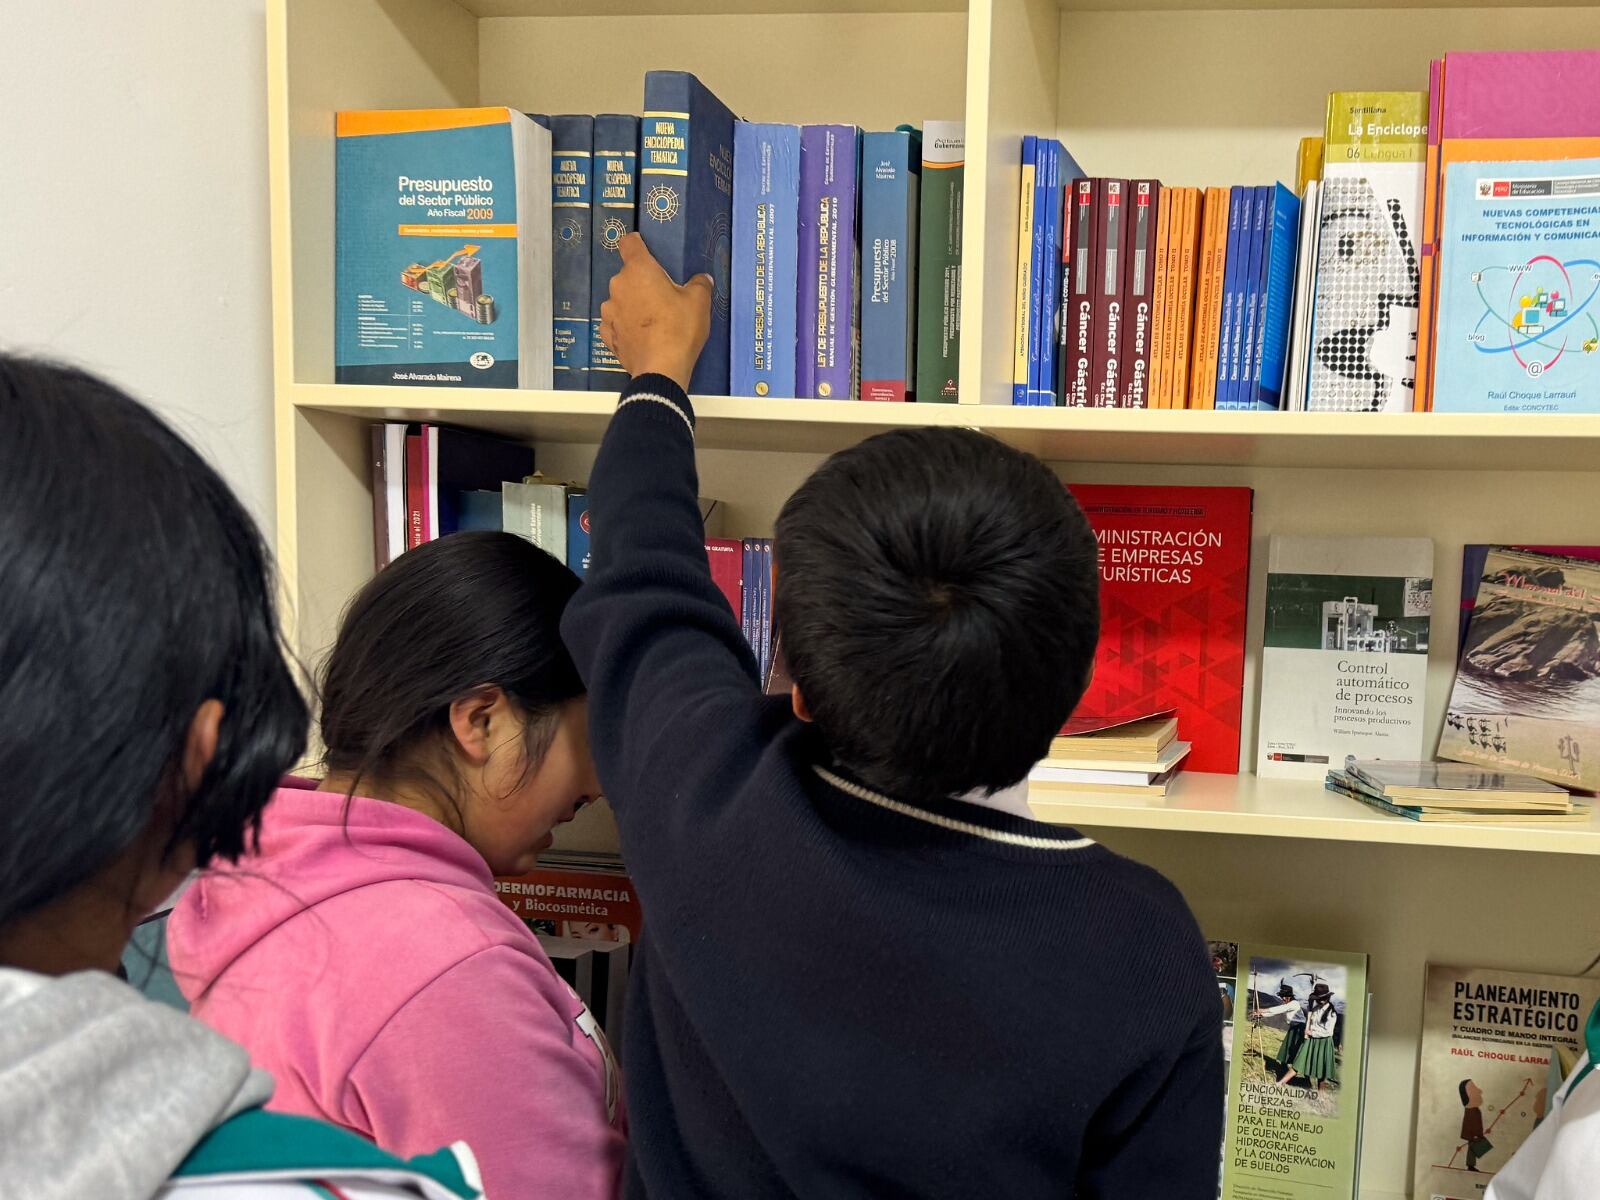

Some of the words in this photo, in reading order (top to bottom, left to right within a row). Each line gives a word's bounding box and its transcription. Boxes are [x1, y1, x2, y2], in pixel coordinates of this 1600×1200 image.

[1350, 107, 1387, 115] Santillana
[655, 122, 675, 135] NUEVA
[1348, 123, 1363, 137] La
[644, 136, 685, 150] ENCICLOPEDIA
[650, 151, 678, 165] TEMATICA
[1346, 147, 1360, 159] 06
[560, 160, 577, 172] NUEVA
[606, 160, 624, 172] NUEVA
[398, 175, 493, 195] Presupuesto
[398, 194, 416, 206] del
[417, 194, 453, 206] Sector
[454, 193, 494, 206] Público
[427, 208, 443, 217] Año
[443, 208, 466, 217] Fiscal
[466, 208, 493, 220] 2009
[817, 197, 829, 245] REPÚBLICA
[1482, 209, 1522, 217] NUEVAS
[756, 203, 766, 251] REPUBLICA
[1495, 219, 1573, 230] TECNOLÓGICAS
[1576, 219, 1590, 227] EN
[1461, 232, 1531, 242] INFORMACIÓN
[1534, 233, 1541, 241] Y
[756, 252, 765, 264] LA
[819, 247, 828, 259] LA
[756, 265, 765, 277] DE
[819, 260, 828, 273] DE
[871, 238, 883, 303] Presupuesto
[755, 278, 765, 340] PRESUPUESTO
[818, 274, 828, 336] PRESUPUESTO
[767, 328, 773, 338] DE
[829, 325, 835, 335] DE
[1078, 301, 1090, 353] Cáncer
[1107, 302, 1119, 355] Cáncer
[1135, 302, 1148, 355] Cáncer
[755, 341, 764, 352] DE
[817, 338, 826, 350] DE
[755, 353, 763, 370] LEY
[817, 351, 826, 367] LEY
[392, 372, 408, 380] José
[408, 372, 437, 381] Alvarado
[437, 373, 462, 382] Mairena
[1527, 361, 1543, 377] @
[1076, 358, 1088, 408] Gástri
[1105, 358, 1117, 408] Gástri
[1133, 359, 1145, 409] Gástri
[1487, 391, 1506, 400] Raúl
[1508, 391, 1542, 401] Choque
[1543, 390, 1577, 399] Larrauri
[1111, 548, 1204, 566] EMPRESAS
[1337, 660, 1388, 675] Control
[1336, 676, 1410, 690] automático
[1335, 688, 1351, 702] de
[1355, 692, 1413, 705] procesos
[1334, 706, 1374, 716] Innovando
[1375, 707, 1387, 716] los
[1333, 714, 1366, 724] procesos
[1367, 716, 1412, 726] productivos
[494, 881, 630, 903] DERMOFARMACIA
[512, 899, 521, 912] y
[525, 899, 609, 916] Biocosmética
[1454, 981, 1580, 1011] PLANEAMIENTO
[1453, 1002, 1578, 1032] ESTRATÉGICO
[1460, 1026, 1493, 1035] CUADRO
[1508, 1031, 1537, 1040] MANDO
[1539, 1034, 1578, 1044] INTEGRAL
[1451, 1047, 1475, 1057] RAÚL
[1477, 1050, 1516, 1062] CHOQUE
[1519, 1056, 1549, 1065] LARRA
[1240, 1082, 1319, 1101] FUNCIONALIDAD
[1239, 1093, 1246, 1103] Y
[1248, 1095, 1293, 1109] FUERZAS
[1238, 1104, 1257, 1116] DEL
[1237, 1115, 1264, 1127] PARA
[1266, 1118, 1278, 1128] EL
[1280, 1120, 1324, 1135] MANEJO
[1236, 1126, 1250, 1136] DE
[1252, 1127, 1300, 1142] CUENCAS
[1236, 1136, 1317, 1156] HIDROGRAFICAS
[1234, 1158, 1248, 1168] DE
[1250, 1160, 1290, 1175] SUELOS
[1235, 1147, 1242, 1157] Y
[1244, 1149, 1257, 1159] LA
[1259, 1150, 1336, 1170] CONSERVACION
